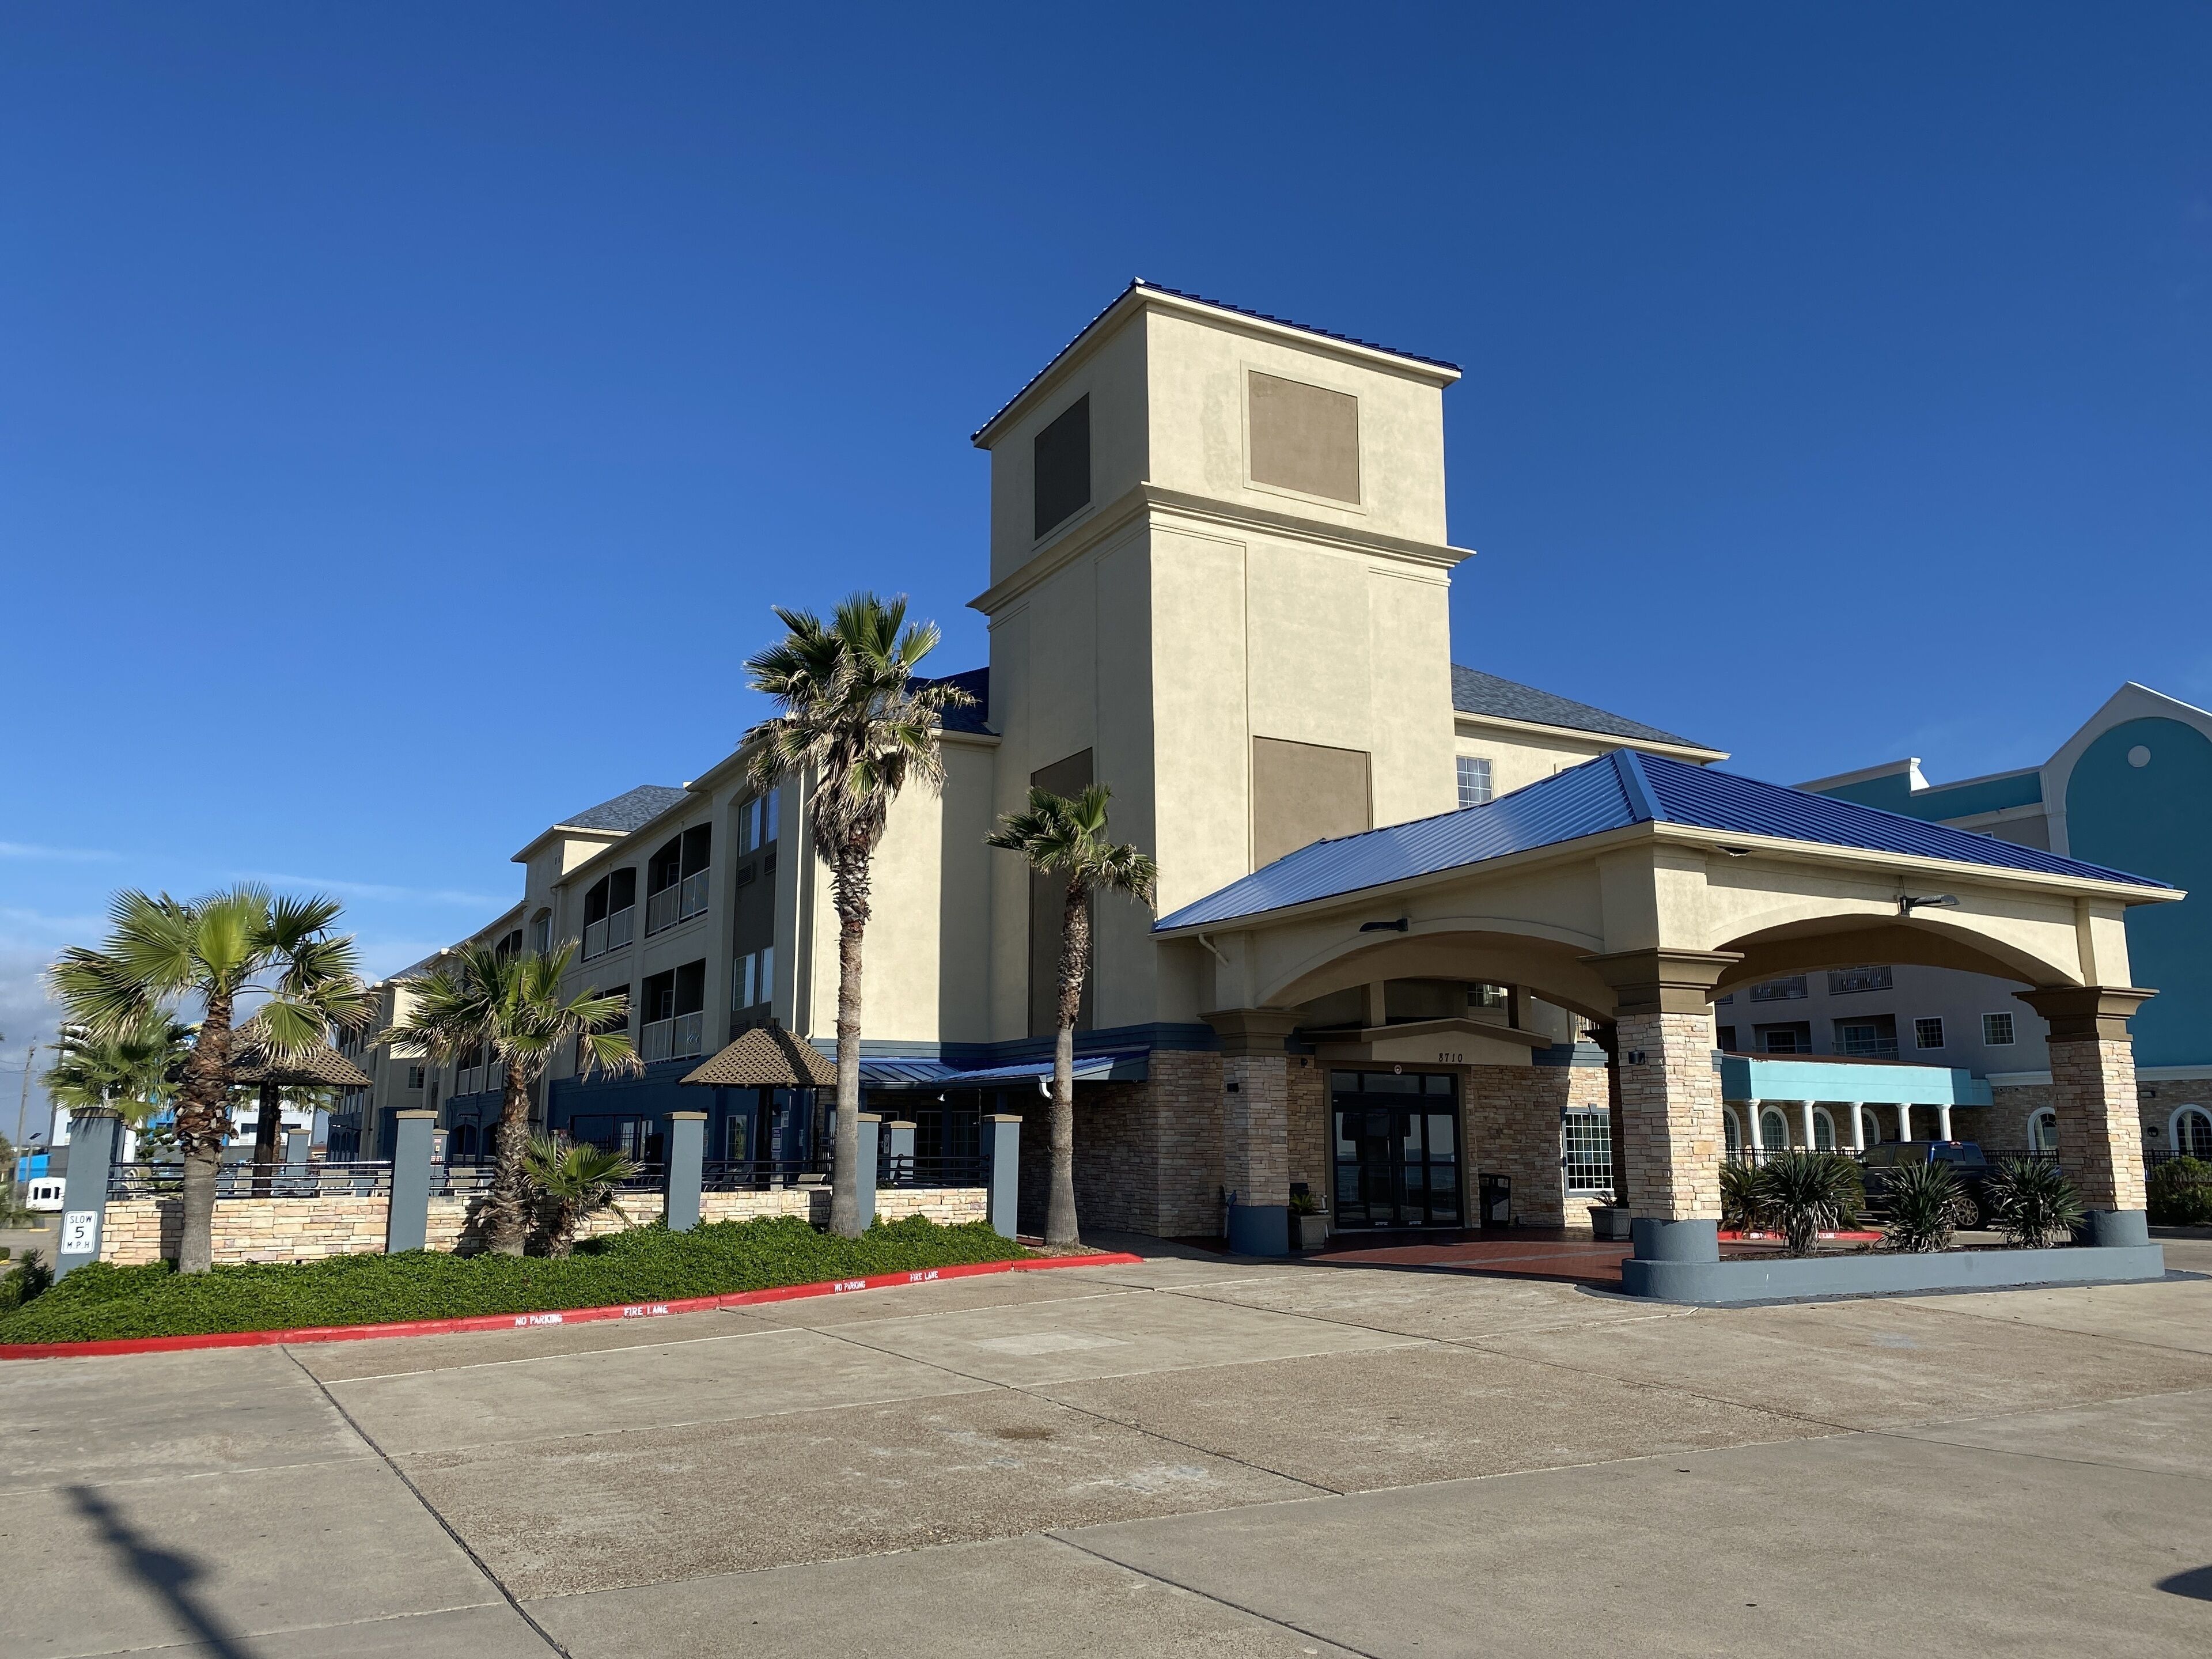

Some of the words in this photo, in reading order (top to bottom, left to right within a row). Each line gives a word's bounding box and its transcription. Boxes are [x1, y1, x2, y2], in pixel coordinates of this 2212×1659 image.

[1438, 1052, 1463, 1063] 8710
[70, 1215, 92, 1224] SLOW
[74, 1226, 85, 1238] 5
[910, 1272, 923, 1283] FIRE
[924, 1270, 939, 1280] LANE
[834, 1283, 843, 1293] NO
[844, 1280, 866, 1291] PARKING
[624, 1306, 643, 1316] FIRE
[647, 1304, 668, 1315] LANE
[515, 1316, 527, 1326] NO
[529, 1314, 563, 1325] PARKING
